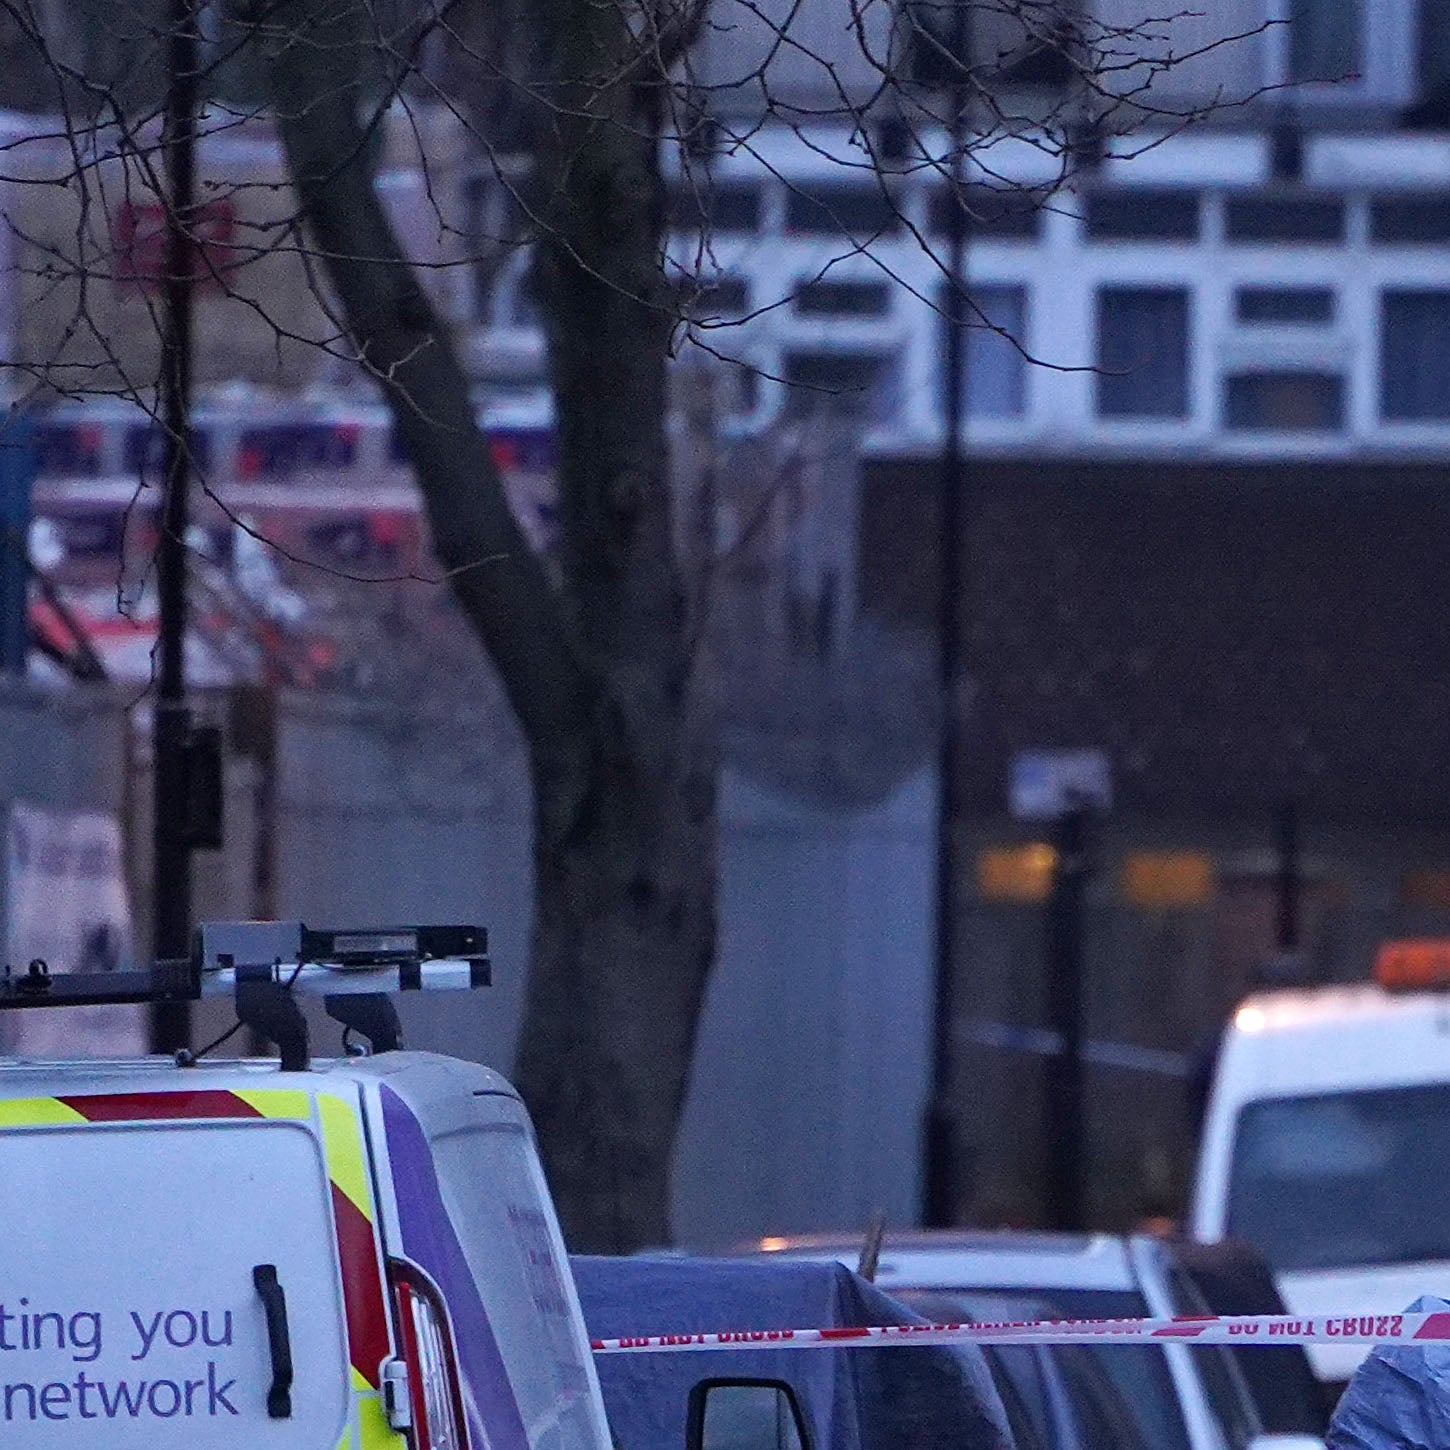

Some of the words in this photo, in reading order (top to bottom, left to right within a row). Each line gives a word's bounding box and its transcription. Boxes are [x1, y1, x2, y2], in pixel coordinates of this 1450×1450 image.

[0, 1298, 101, 1361] ting
[130, 1310, 233, 1361] you
[4, 1362, 239, 1421] network
